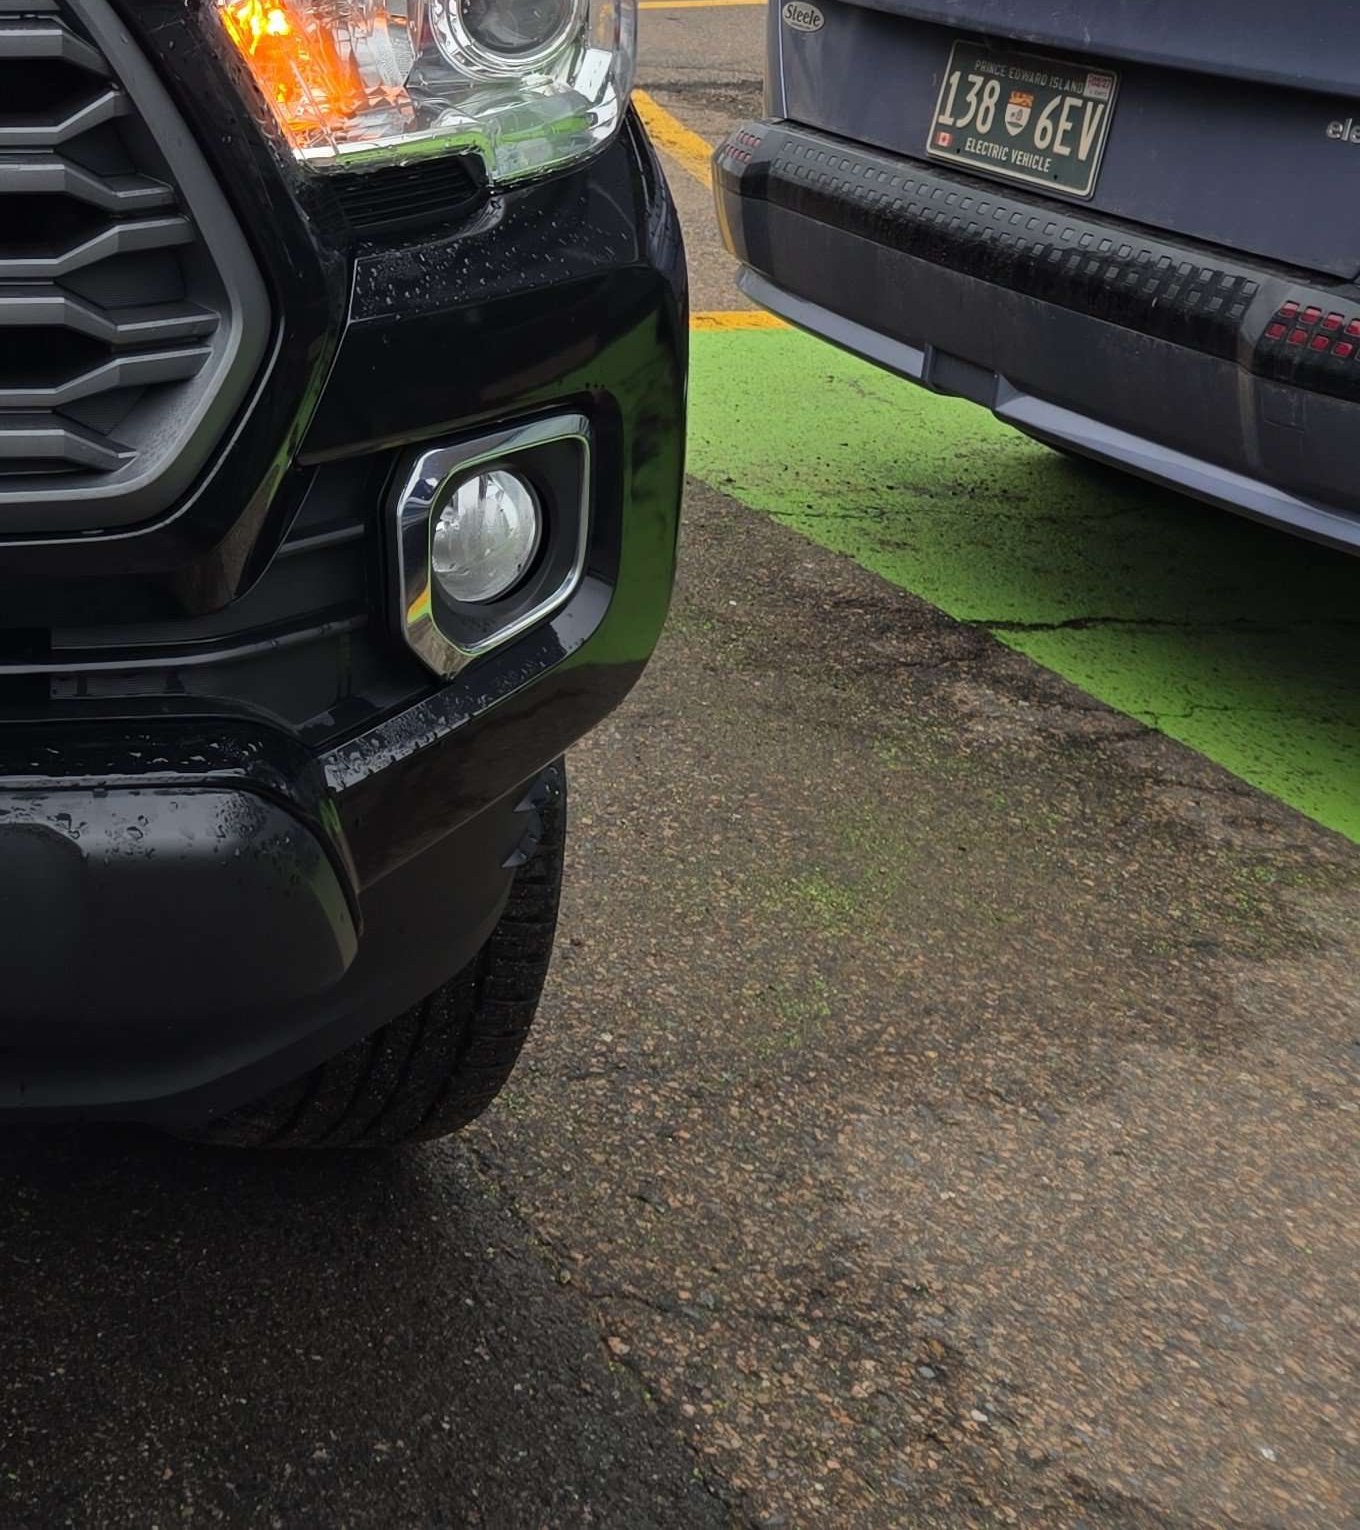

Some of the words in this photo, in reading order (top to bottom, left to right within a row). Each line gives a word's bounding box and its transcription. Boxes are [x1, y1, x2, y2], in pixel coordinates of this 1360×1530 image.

[974, 59, 1007, 78] PRINCE
[1008, 67, 1049, 86] EDWARD
[1049, 75, 1084, 94] ISLAND
[938, 70, 1001, 135] 138
[1033, 95, 1105, 162] 6EV
[964, 137, 1009, 161] ELECTRIC
[1011, 149, 1053, 173] VEHICLE
